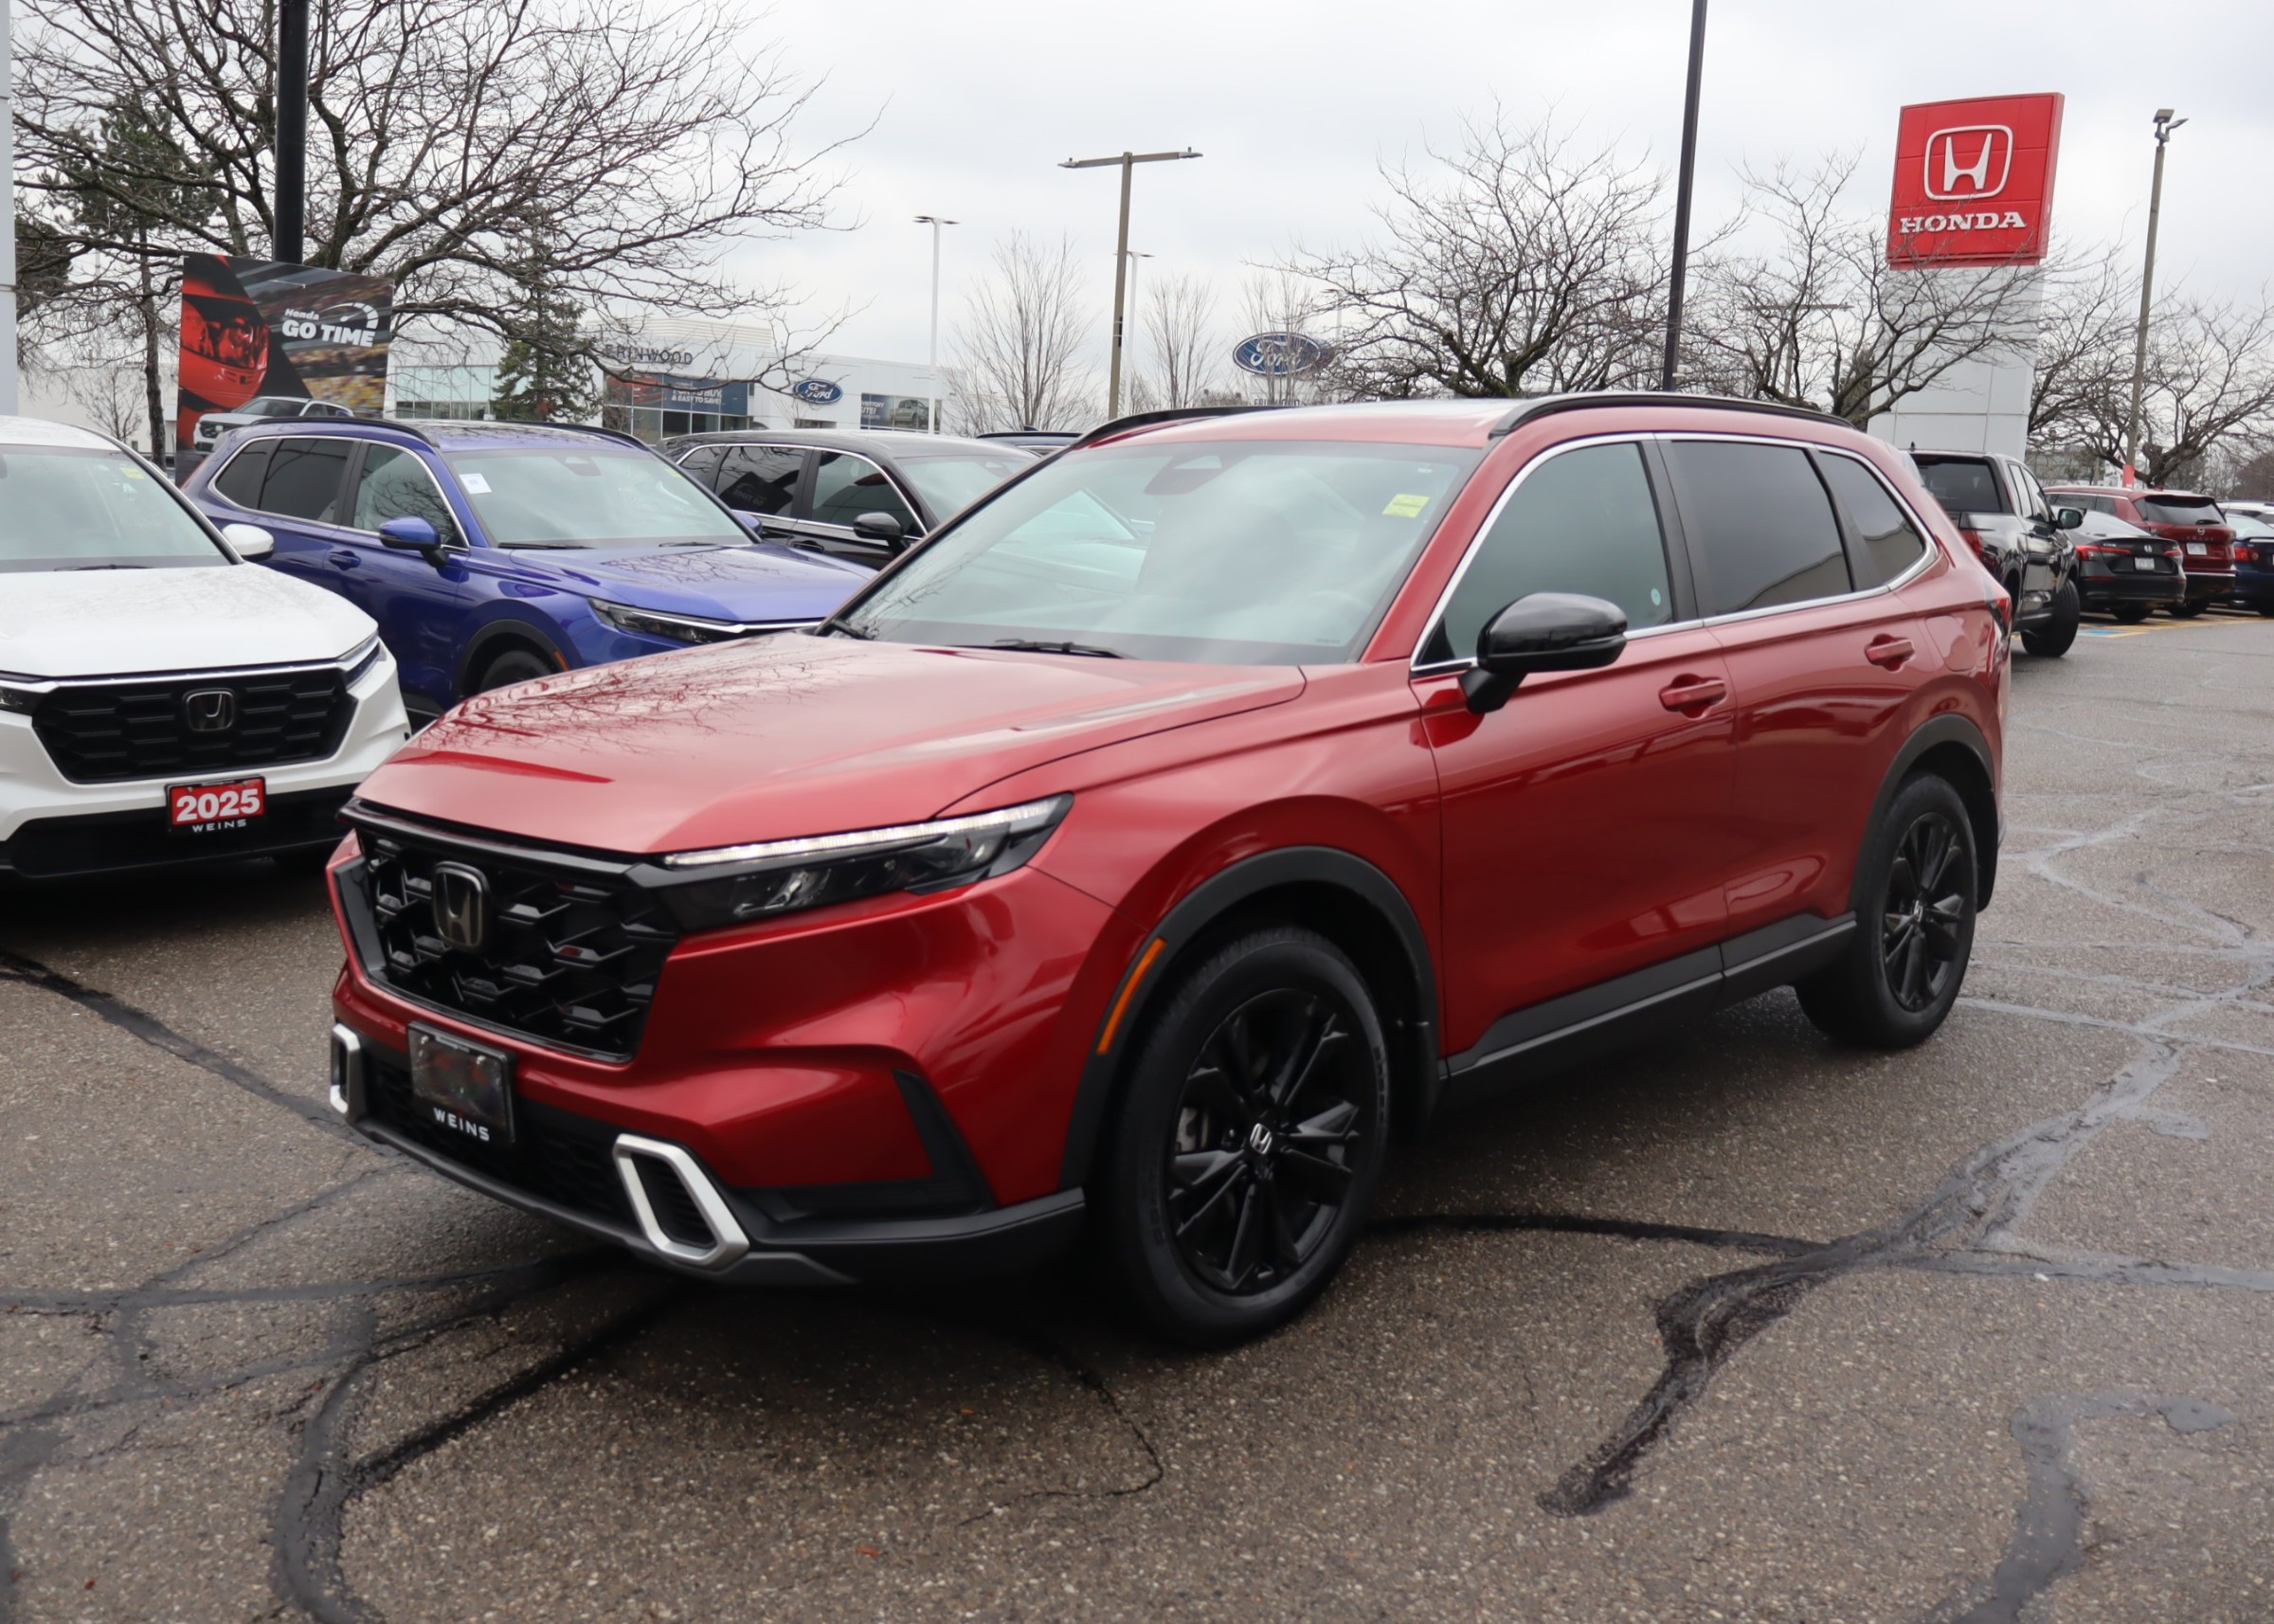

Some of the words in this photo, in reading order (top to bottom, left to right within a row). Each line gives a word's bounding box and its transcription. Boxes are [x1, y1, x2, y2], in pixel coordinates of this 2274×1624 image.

[1899, 211, 2027, 233] HONDA
[284, 308, 320, 320] Honda
[282, 319, 317, 339] GO
[320, 324, 376, 348] TIME
[605, 344, 693, 366] ERINWOOD
[805, 382, 833, 401] Ford
[176, 788, 261, 822] 2025
[191, 819, 247, 833] WEINS
[433, 1107, 491, 1142] WEINS
